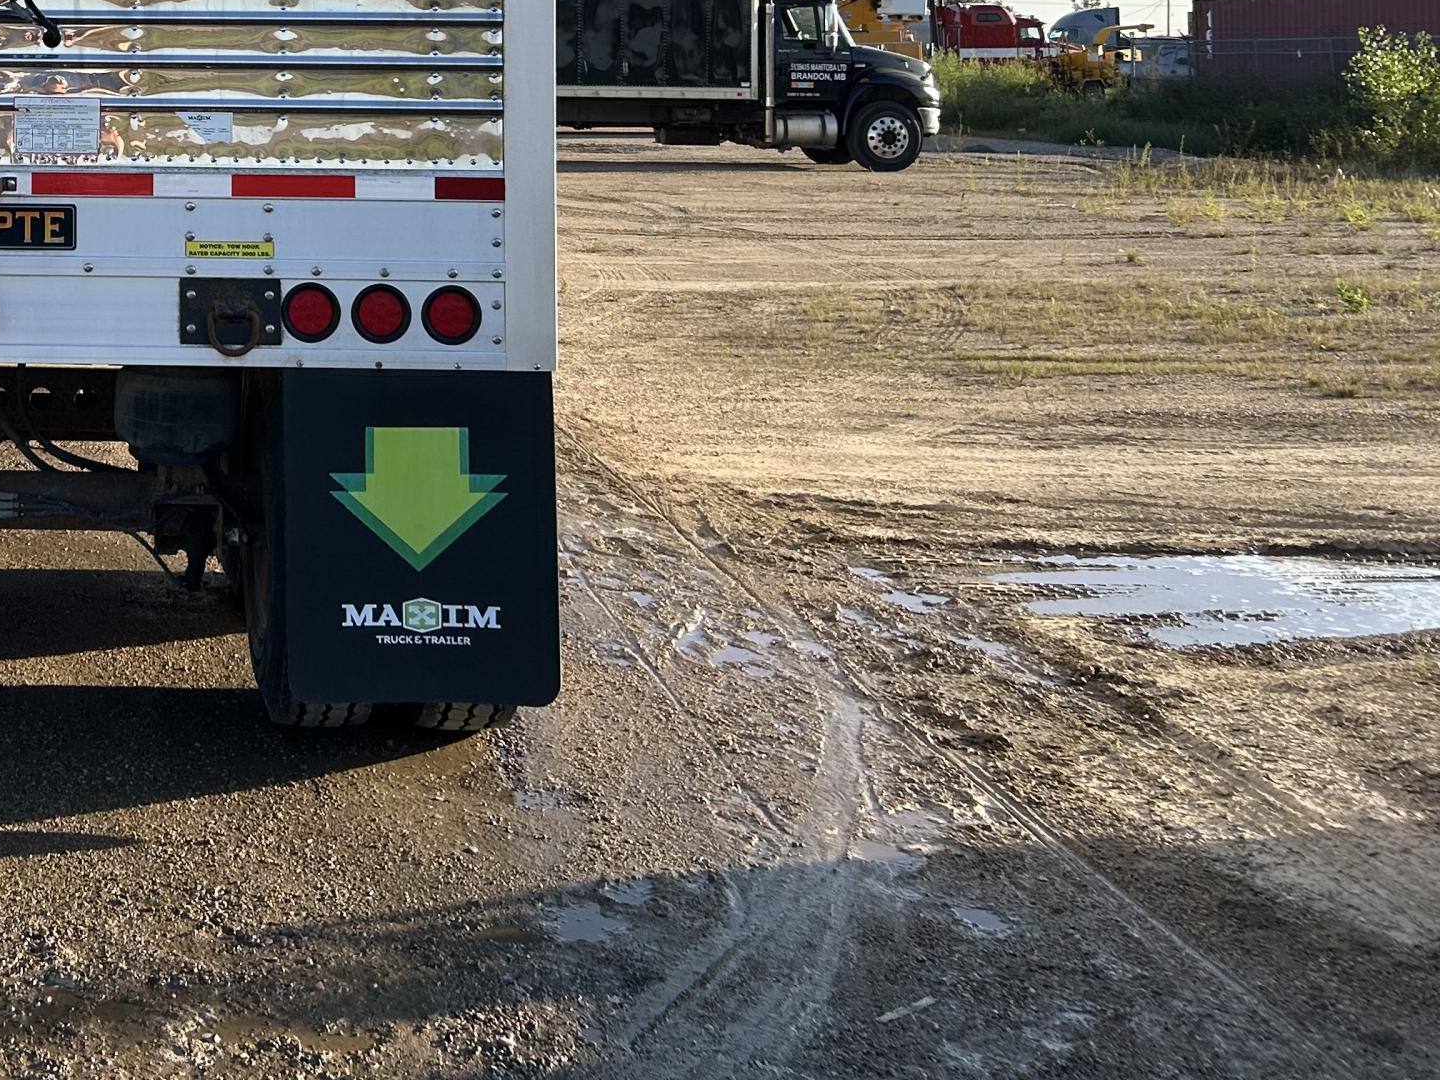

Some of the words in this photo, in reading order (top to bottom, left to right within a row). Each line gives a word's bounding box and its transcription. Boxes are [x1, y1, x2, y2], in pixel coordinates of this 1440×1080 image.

[810, 63, 837, 72] MANITOBA
[837, 64, 847, 72] LTD
[790, 72, 833, 81] BRANDON,
[834, 73, 847, 81] MB
[341, 597, 502, 634] MAXIM
[375, 635, 414, 645] TRUCK
[423, 636, 472, 646] TRAILER
